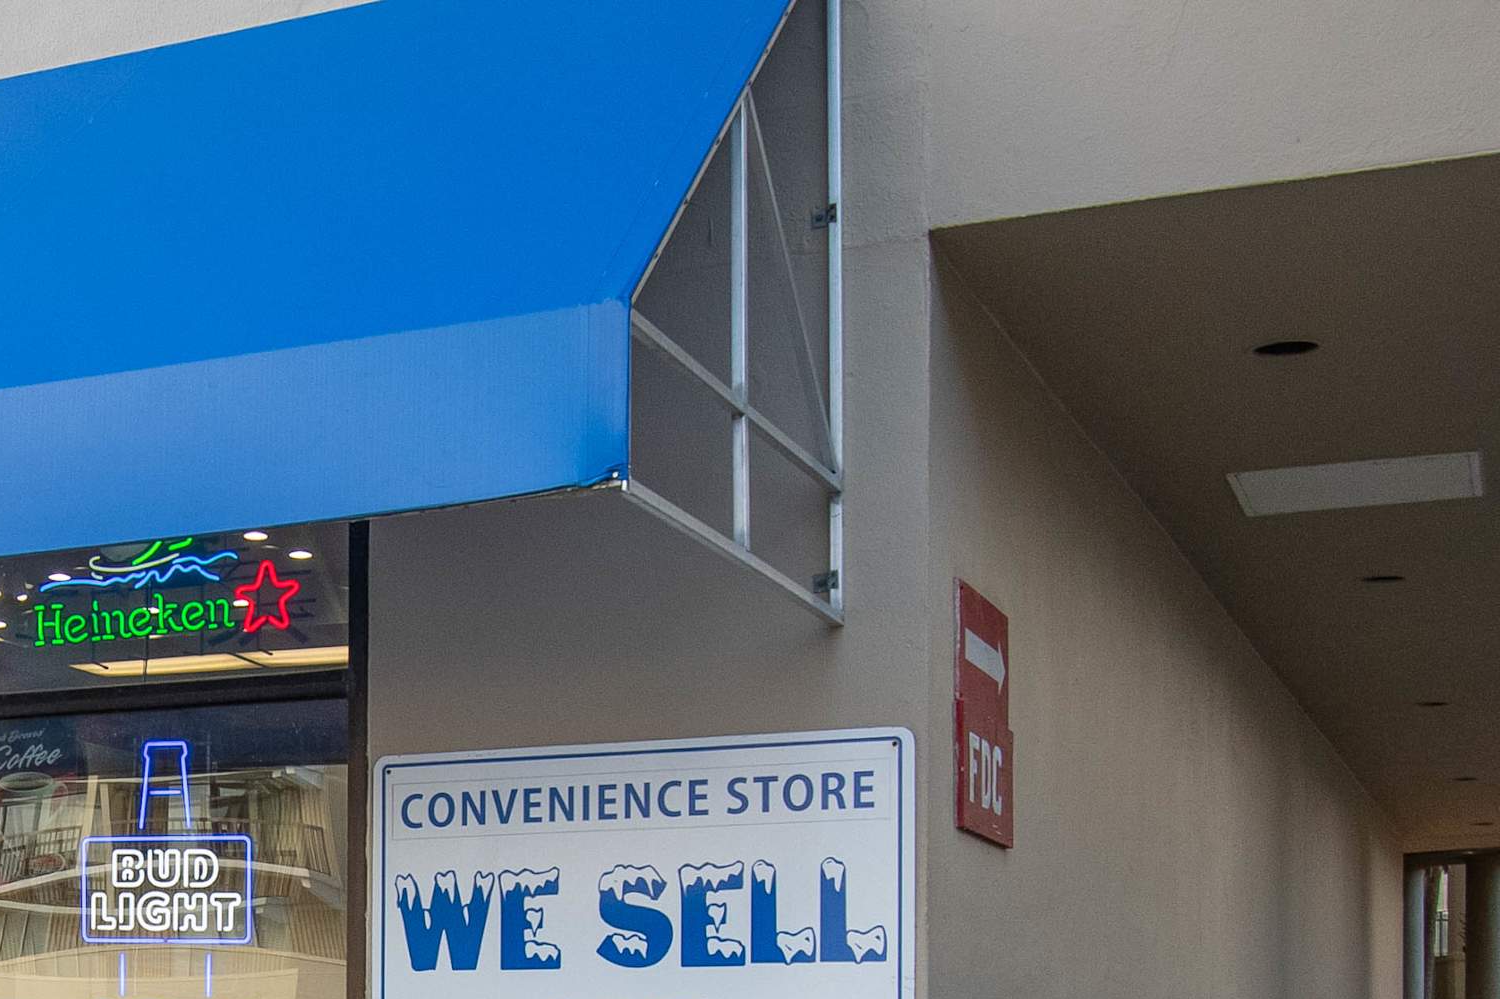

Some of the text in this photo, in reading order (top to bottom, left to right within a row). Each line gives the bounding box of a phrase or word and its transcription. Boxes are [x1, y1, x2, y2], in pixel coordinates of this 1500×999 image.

[34, 593, 236, 647] Heineken
[400, 770, 876, 829] CONVENIENCE STORE
[968, 731, 1003, 816] FDC
[111, 848, 220, 889] BUD
[90, 891, 242, 932] LIGHT
[394, 856, 888, 972] WE SELL
